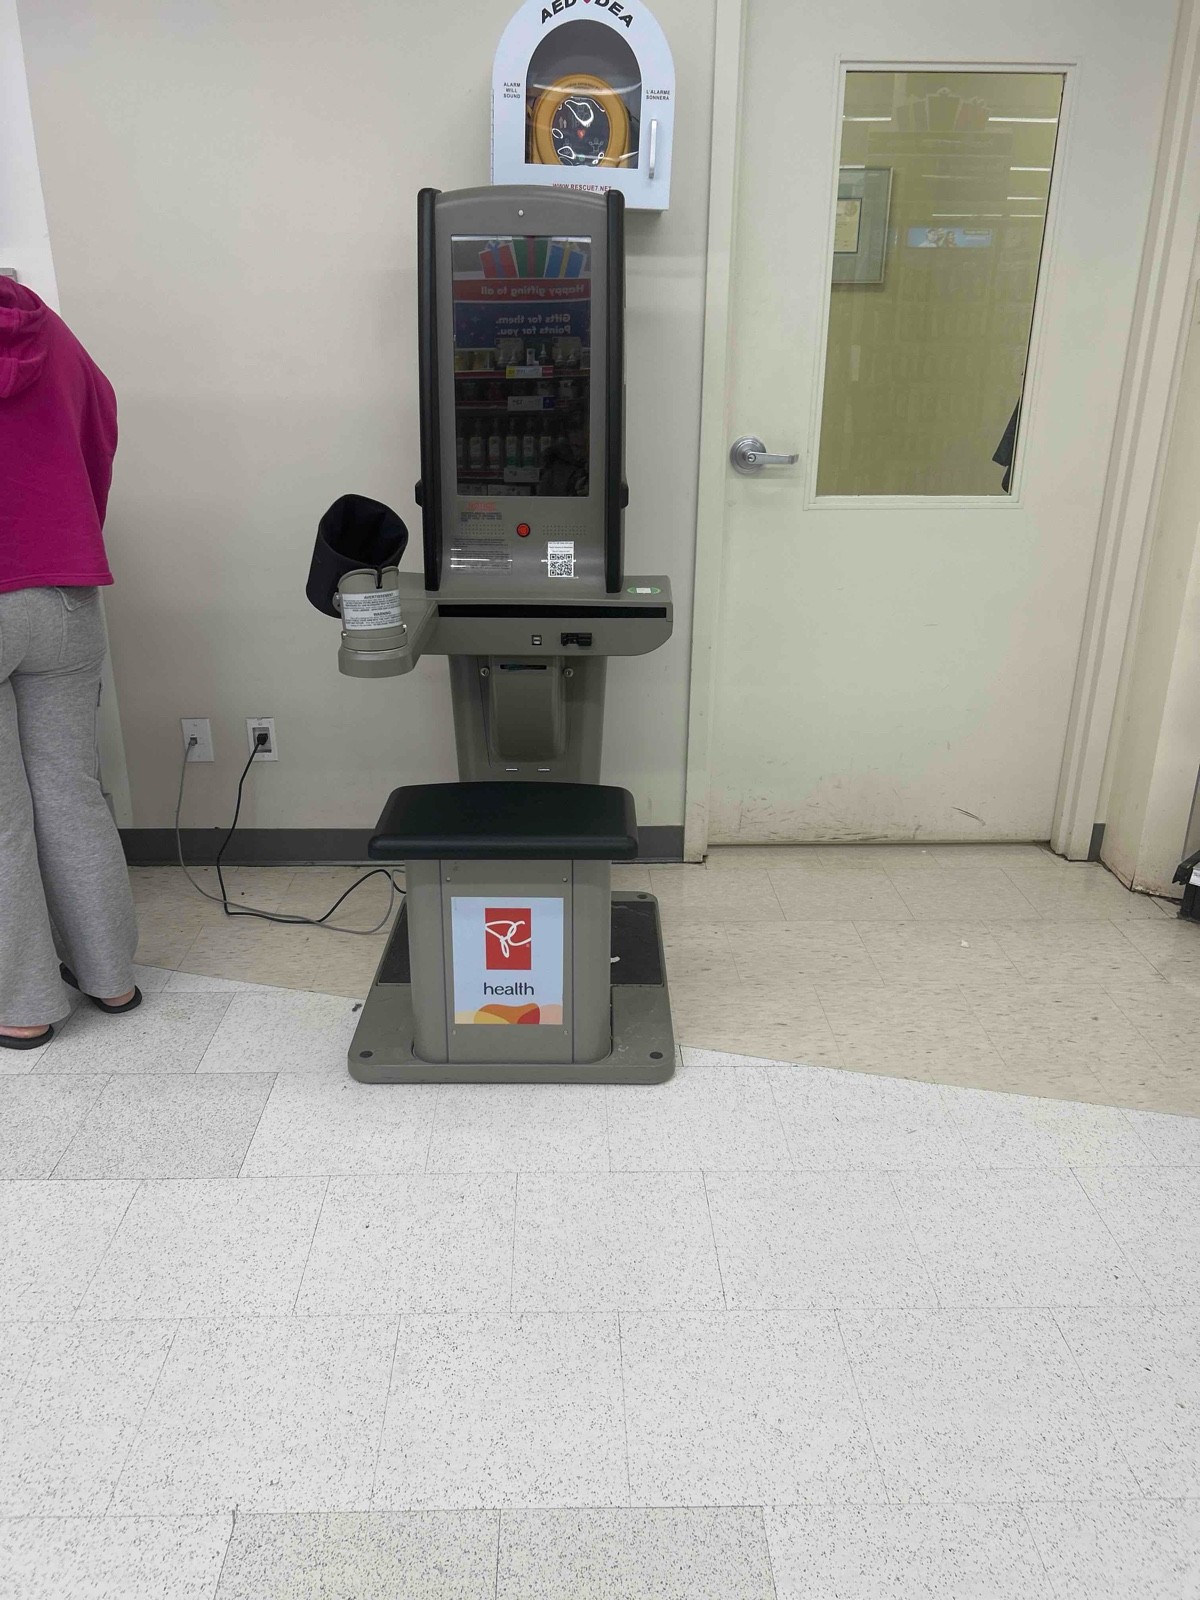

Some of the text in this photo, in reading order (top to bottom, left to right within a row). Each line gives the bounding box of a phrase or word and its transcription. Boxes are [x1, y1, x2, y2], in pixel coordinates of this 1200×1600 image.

[541, 0, 634, 29] AED DEA
[483, 982, 535, 996] health
